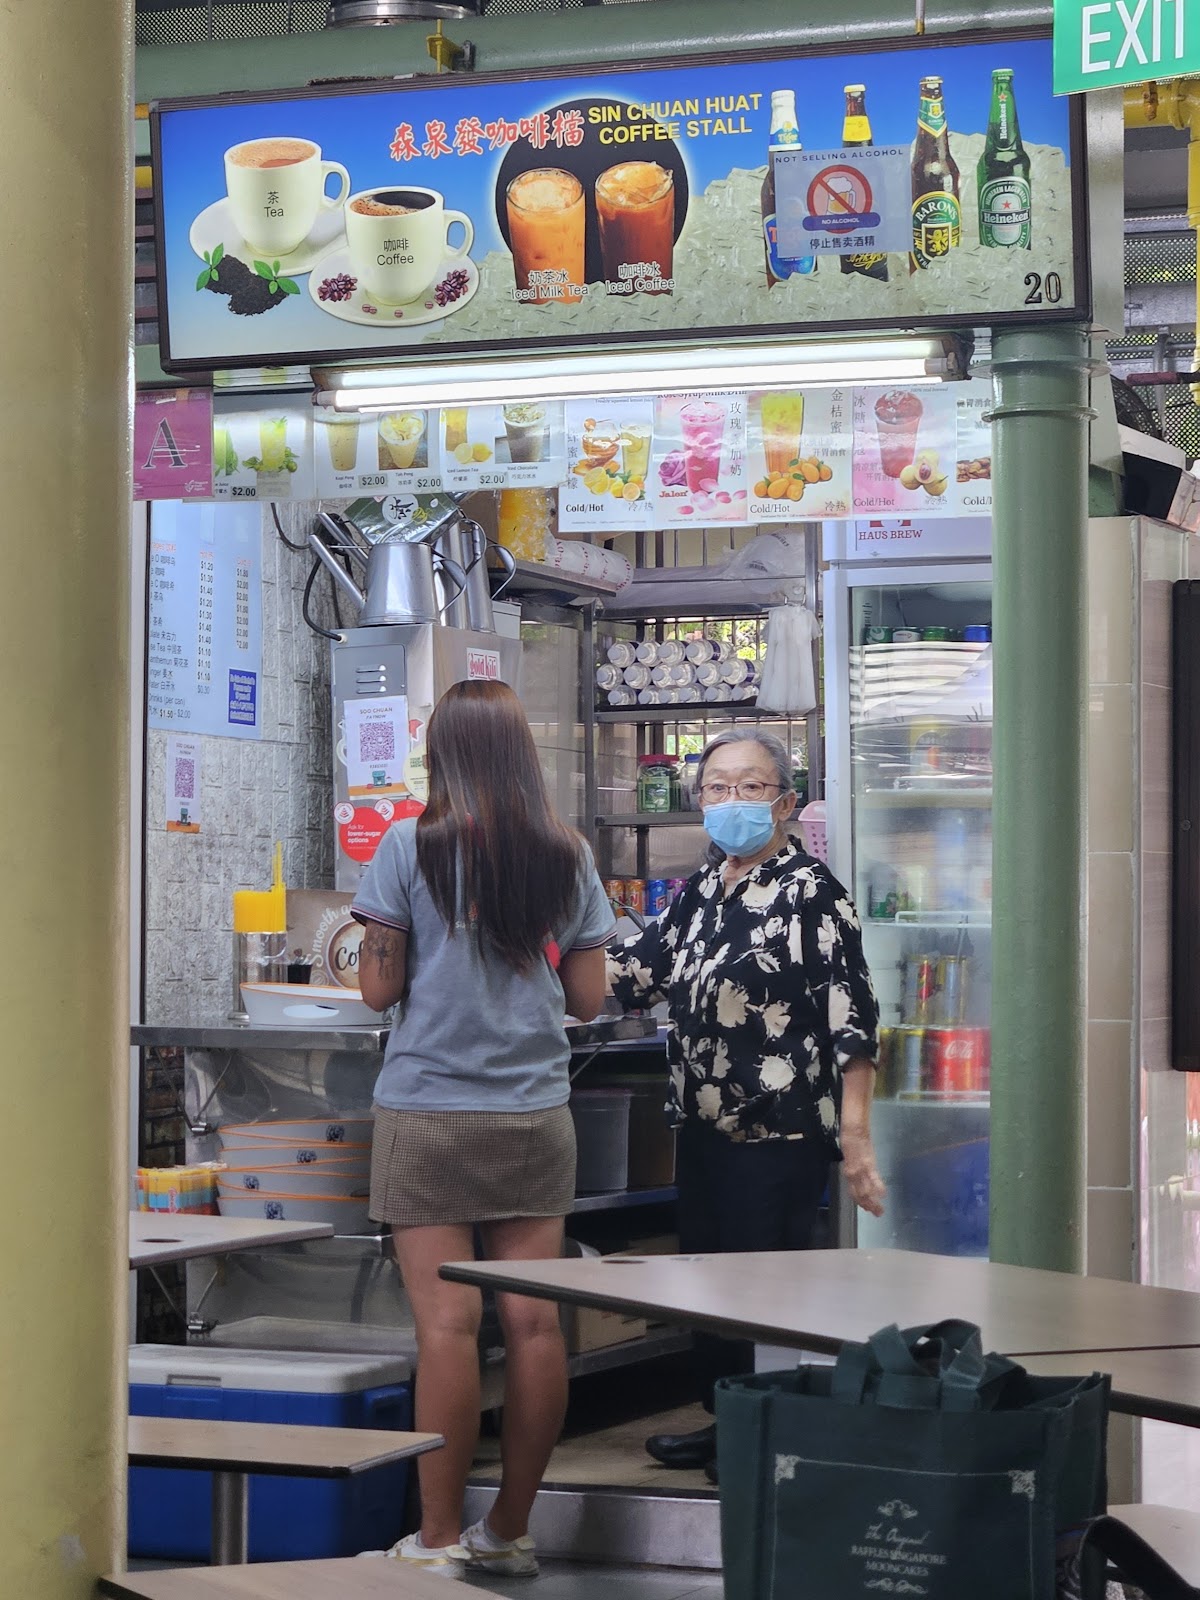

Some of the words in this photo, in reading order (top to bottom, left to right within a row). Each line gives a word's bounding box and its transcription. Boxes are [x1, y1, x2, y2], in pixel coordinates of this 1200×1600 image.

[1082, 0, 1184, 73] EXIT
[588, 105, 621, 124] SIN
[627, 99, 699, 119] CHUAN
[706, 93, 762, 114] HUAT
[389, 110, 585, 162] 森泉發咖啡檔
[599, 124, 681, 145] COFFEE
[687, 117, 752, 138] STALL
[775, 156, 797, 164] NOT
[801, 153, 847, 162] SELLING
[851, 149, 904, 158] ALCOHOL
[267, 191, 279, 204] 茶
[264, 206, 284, 218] Tea
[984, 211, 1029, 224] Heineken
[383, 238, 409, 251] 咖啡
[809, 236, 875, 249] 停止售卖酒精
[376, 253, 415, 266] Coffee
[528, 268, 569, 286] 奶茶冰
[617, 262, 661, 279] 咖啡冰
[510, 287, 536, 300] Iced
[540, 285, 563, 298] Milk
[567, 283, 589, 296] Tea
[605, 279, 633, 294] Iced
[634, 276, 676, 292] Coffee
[1024, 271, 1063, 305] 20
[830, 388, 844, 434] 金桔蜜
[141, 416, 188, 469] A
[362, 476, 385, 486] $2.00
[417, 478, 441, 488] $2.00
[480, 474, 505, 485] $2.00
[232, 486, 256, 497] $2.00
[566, 503, 604, 513] Cold/Hot
[854, 497, 895, 507] Cold/Hot
[750, 504, 790, 514] Cold/Hot
[858, 530, 888, 541] HAUS
[890, 529, 923, 540] BREW
[373, 706, 393, 714] CHUAN
[347, 830, 381, 838] lower-sugar
[311, 905, 339, 968] Smooth
[851, 1545, 889, 1558] RAFFLES
[889, 1550, 947, 1565] SINGAPORE
[865, 1561, 929, 1577] MOONCAKES
